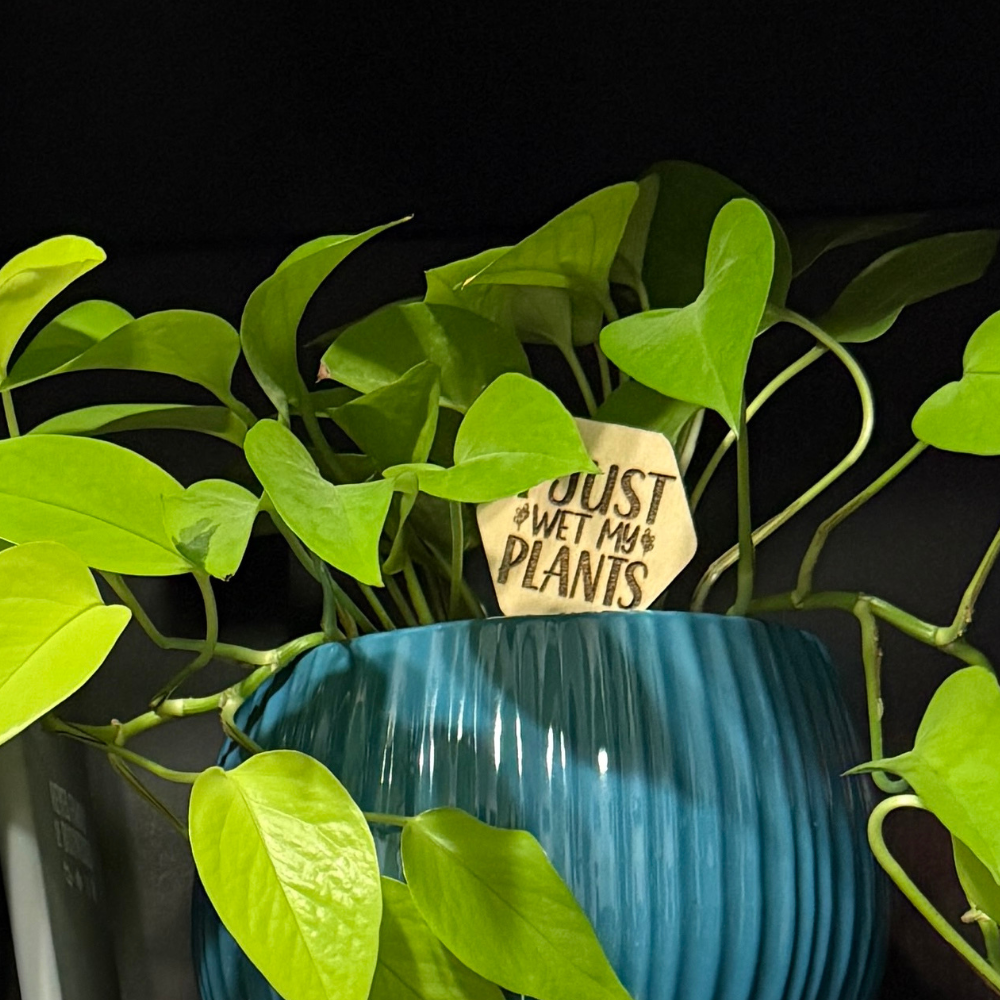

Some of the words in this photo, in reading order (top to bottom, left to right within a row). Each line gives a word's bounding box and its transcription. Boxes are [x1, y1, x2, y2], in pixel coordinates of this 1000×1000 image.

[549, 464, 677, 525] JUST
[532, 504, 593, 544] WET
[597, 518, 641, 554] MY
[497, 534, 649, 610] PLANTS
